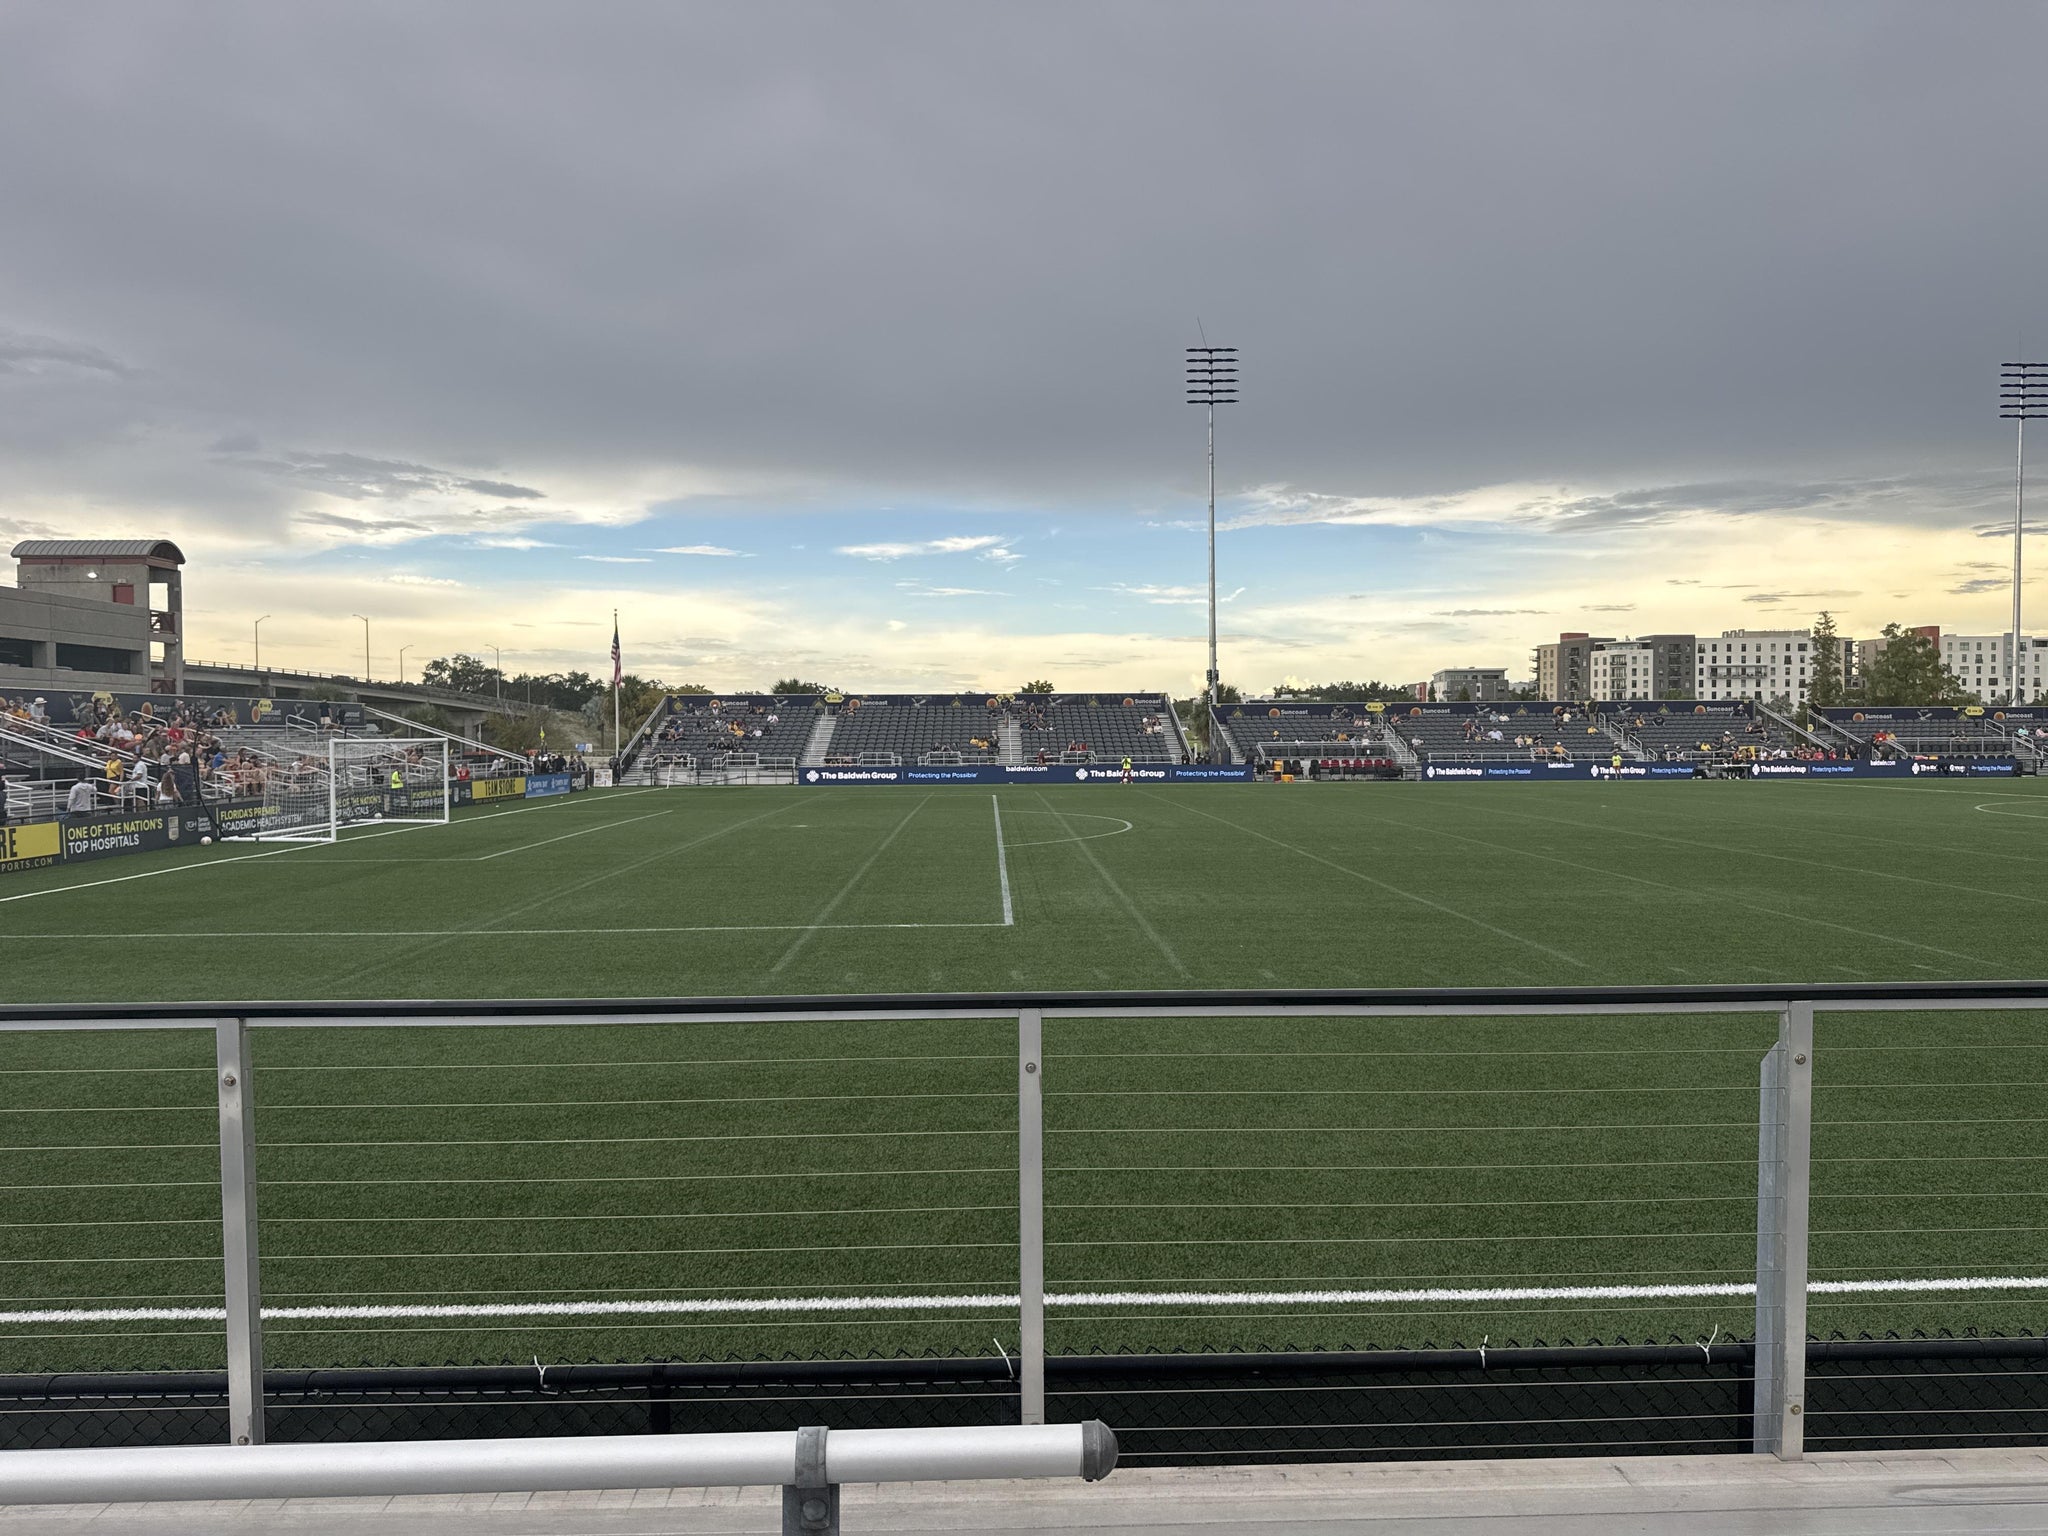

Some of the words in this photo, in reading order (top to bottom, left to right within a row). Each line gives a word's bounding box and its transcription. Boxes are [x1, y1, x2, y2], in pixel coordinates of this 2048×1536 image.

[838, 771, 871, 779] Baldwin
[871, 772, 898, 781] Group
[908, 772, 940, 780] Protecting
[1139, 770, 1166, 779] Group
[1176, 770, 1207, 778] Protecting
[1629, 767, 1646, 775] Group
[1791, 766, 1806, 774] Group
[485, 781, 498, 796] TEAM
[499, 778, 516, 795] STORE
[220, 807, 253, 820] FLORIDA'S
[253, 805, 281, 816] PREMIER
[221, 818, 257, 832] ACADEMIC
[257, 815, 280, 828] HEALTH
[281, 813, 302, 824] SYSTEM
[67, 826, 88, 841] ONE
[90, 824, 103, 837] OF
[104, 822, 122, 835] THE
[123, 818, 163, 833] NATION'S
[68, 840, 89, 854] TOP
[90, 834, 140, 852] HOSPITALS
[1, 857, 53, 872] PORTS.COM
